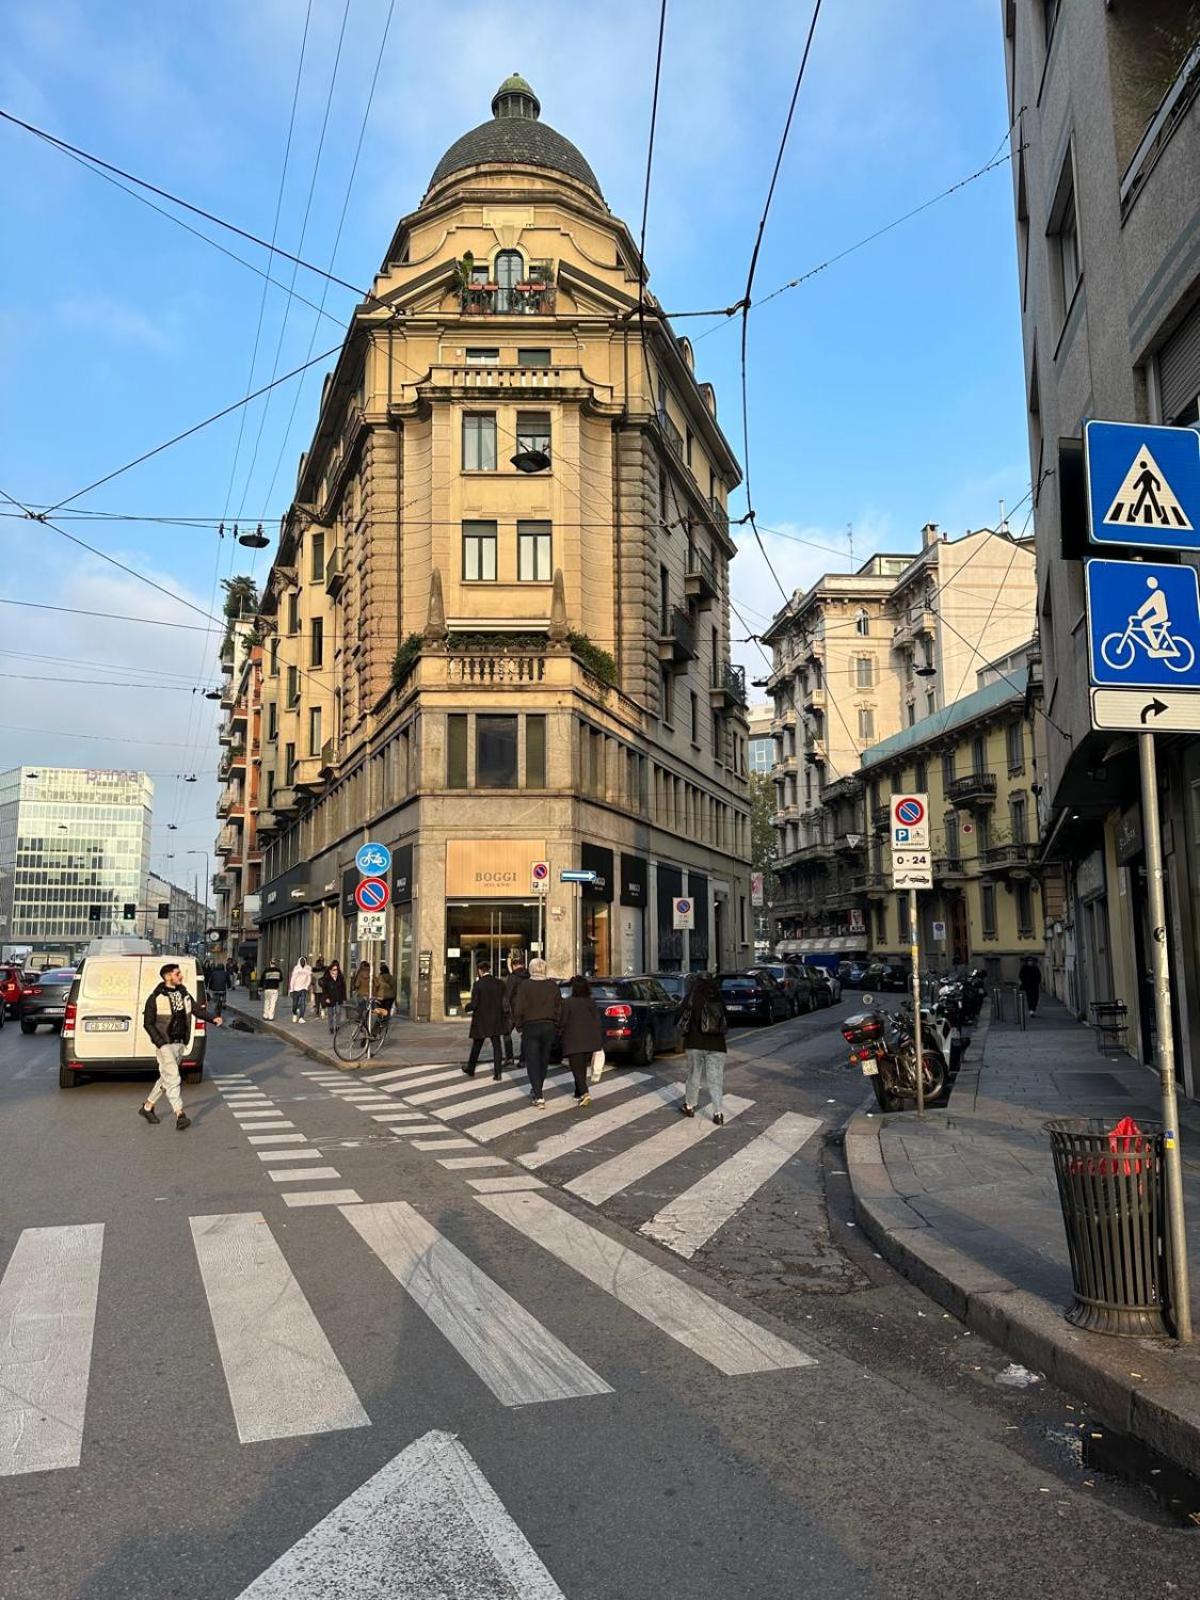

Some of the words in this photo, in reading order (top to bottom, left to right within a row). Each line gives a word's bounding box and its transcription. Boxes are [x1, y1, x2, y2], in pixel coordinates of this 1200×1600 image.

[898, 830, 907, 840] P
[897, 856, 904, 865] 0
[912, 856, 926, 865] 24
[475, 872, 517, 882] BOGGI
